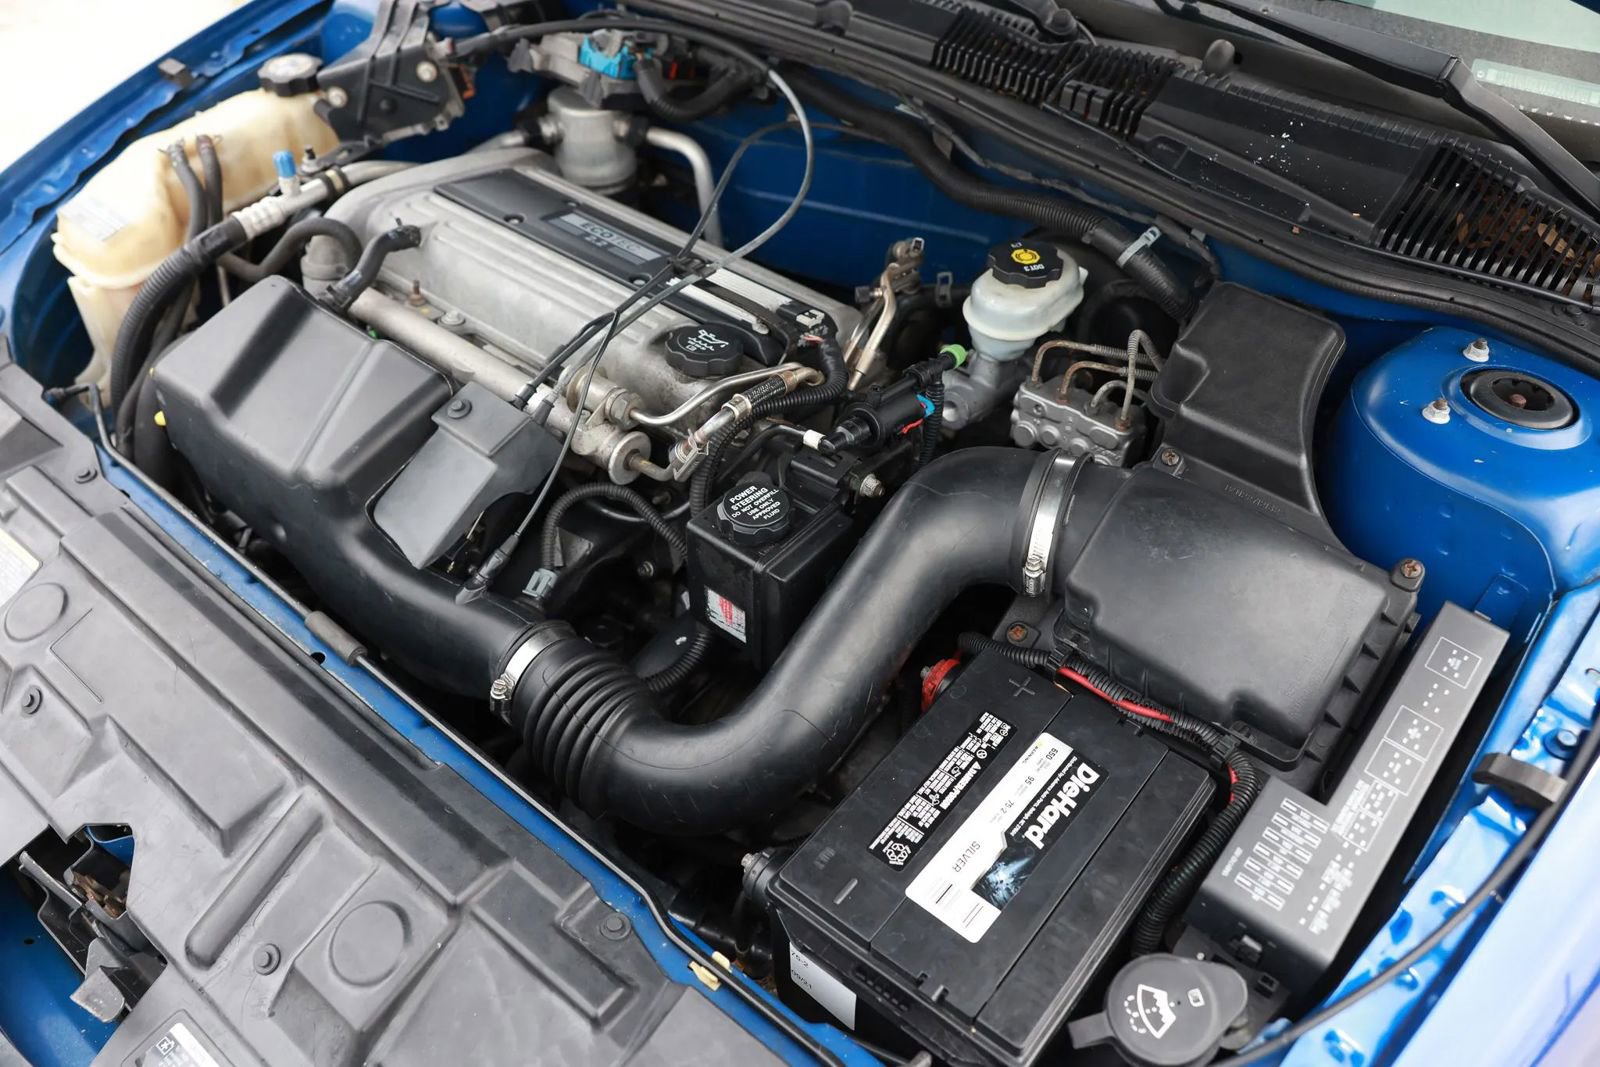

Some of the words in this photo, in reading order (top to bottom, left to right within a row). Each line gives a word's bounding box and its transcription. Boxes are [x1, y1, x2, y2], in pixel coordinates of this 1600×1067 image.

[729, 486, 757, 503] POWER
[731, 488, 768, 510] STEERING
[753, 489, 779, 505] OVERFILL
[752, 501, 781, 520] APPROVED
[759, 498, 774, 509] ONLY
[763, 508, 780, 520] FLUID
[1044, 747, 1059, 760] 650
[1023, 775, 1035, 785] 95
[1021, 762, 1101, 849] DieHard
[952, 840, 981, 873] SILVER
